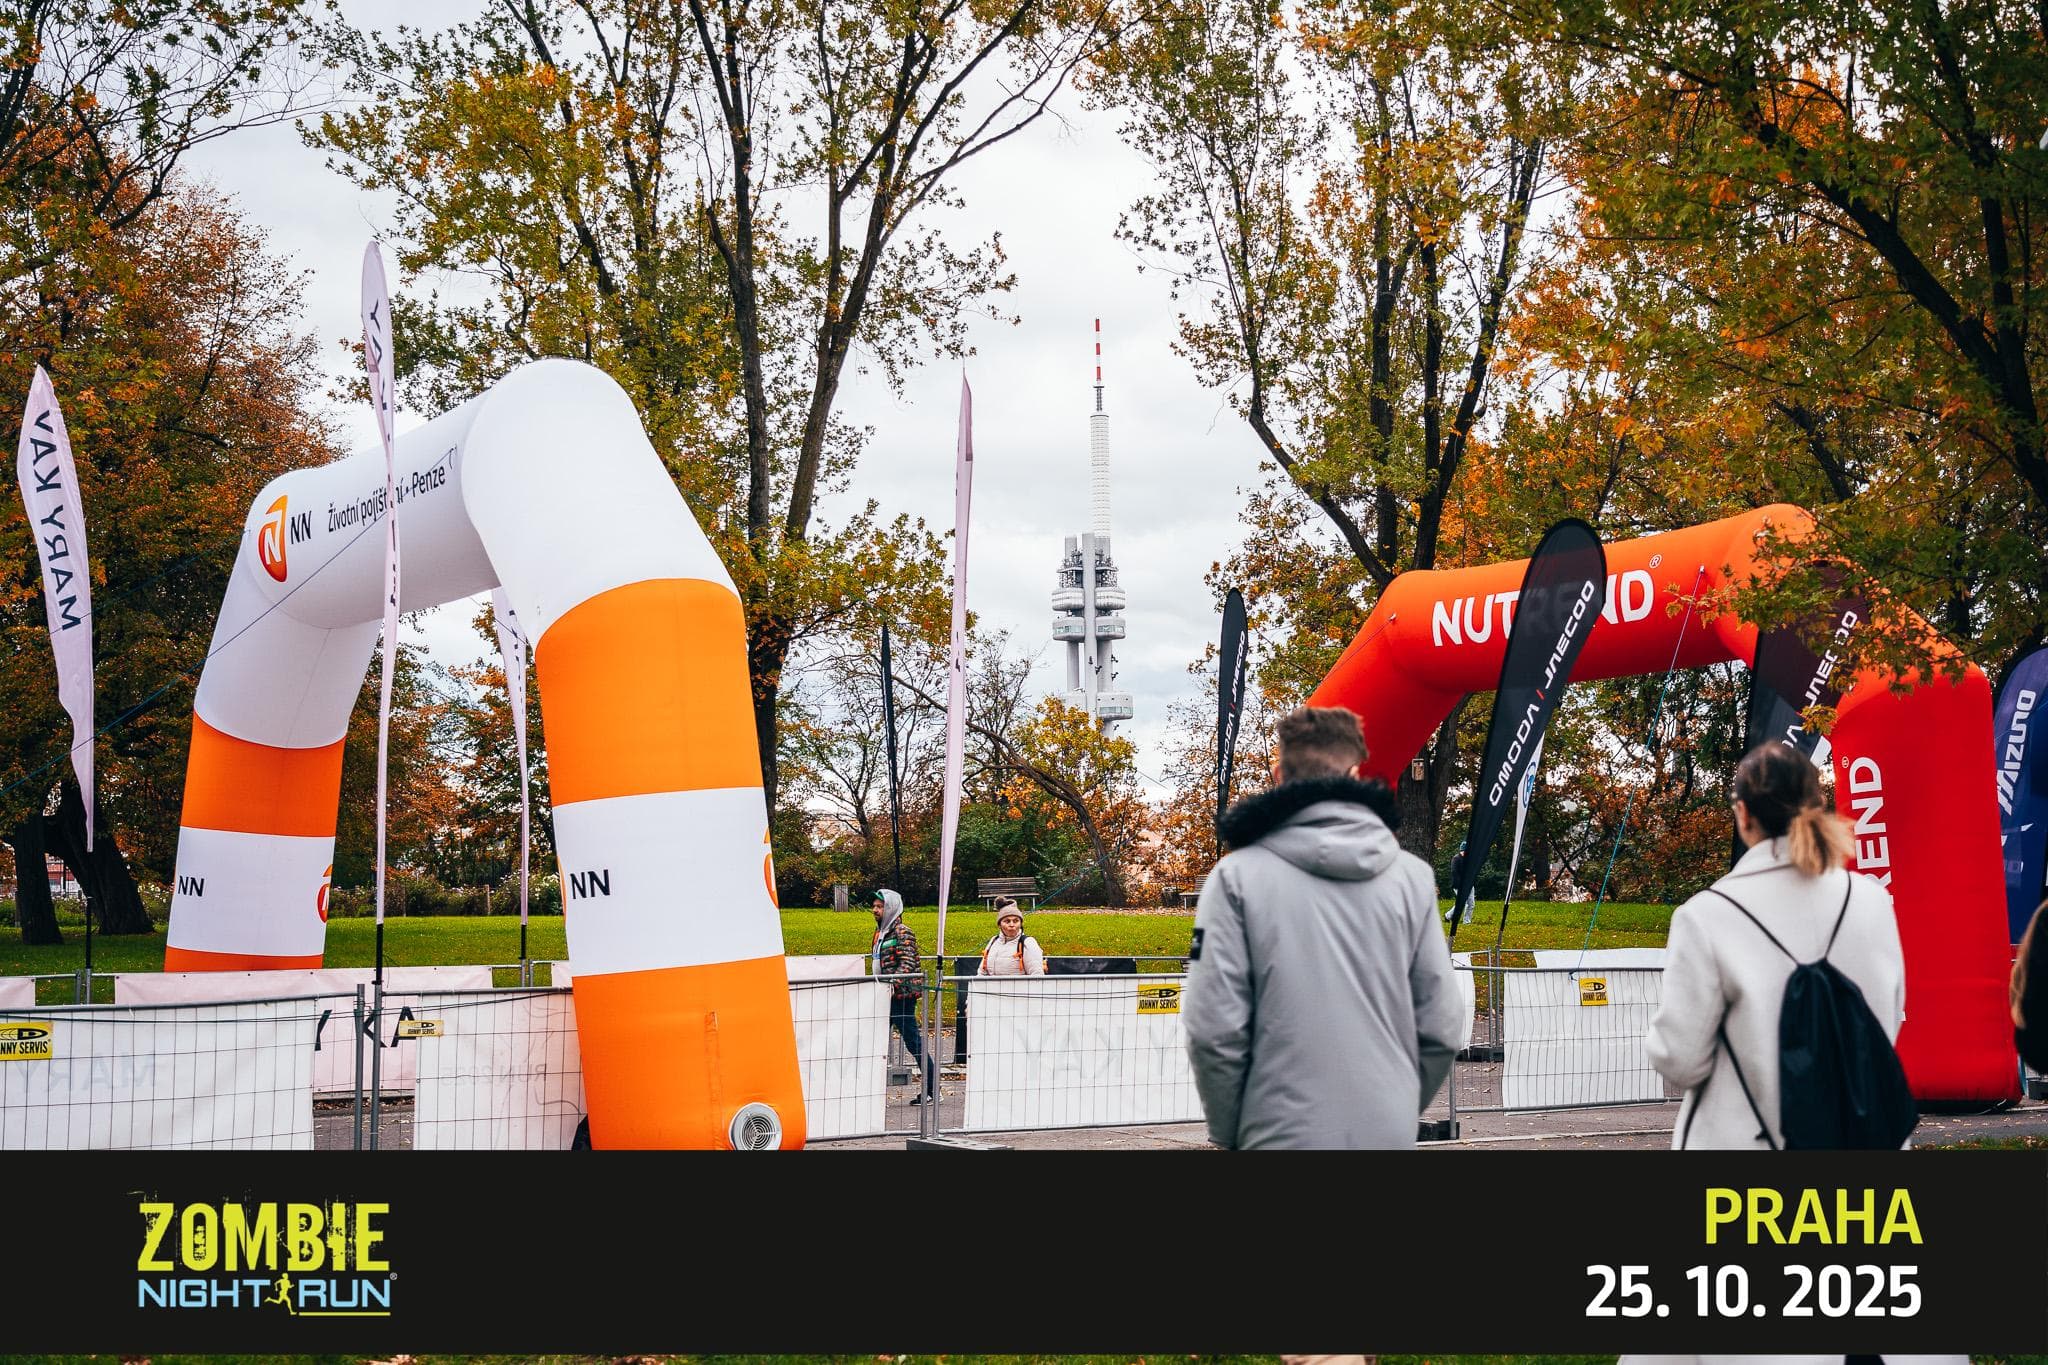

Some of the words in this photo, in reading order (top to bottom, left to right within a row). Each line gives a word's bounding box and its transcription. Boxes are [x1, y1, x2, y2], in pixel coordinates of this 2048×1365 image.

[290, 509, 313, 545] NN
[1544, 580, 1596, 689] JAECOO
[177, 875, 206, 897] NN
[569, 868, 611, 900] NN
[1138, 999, 1160, 1010] JOHNNY
[1160, 998, 1178, 1009] SERVIS
[19, 1040, 48, 1054] SERVIS
